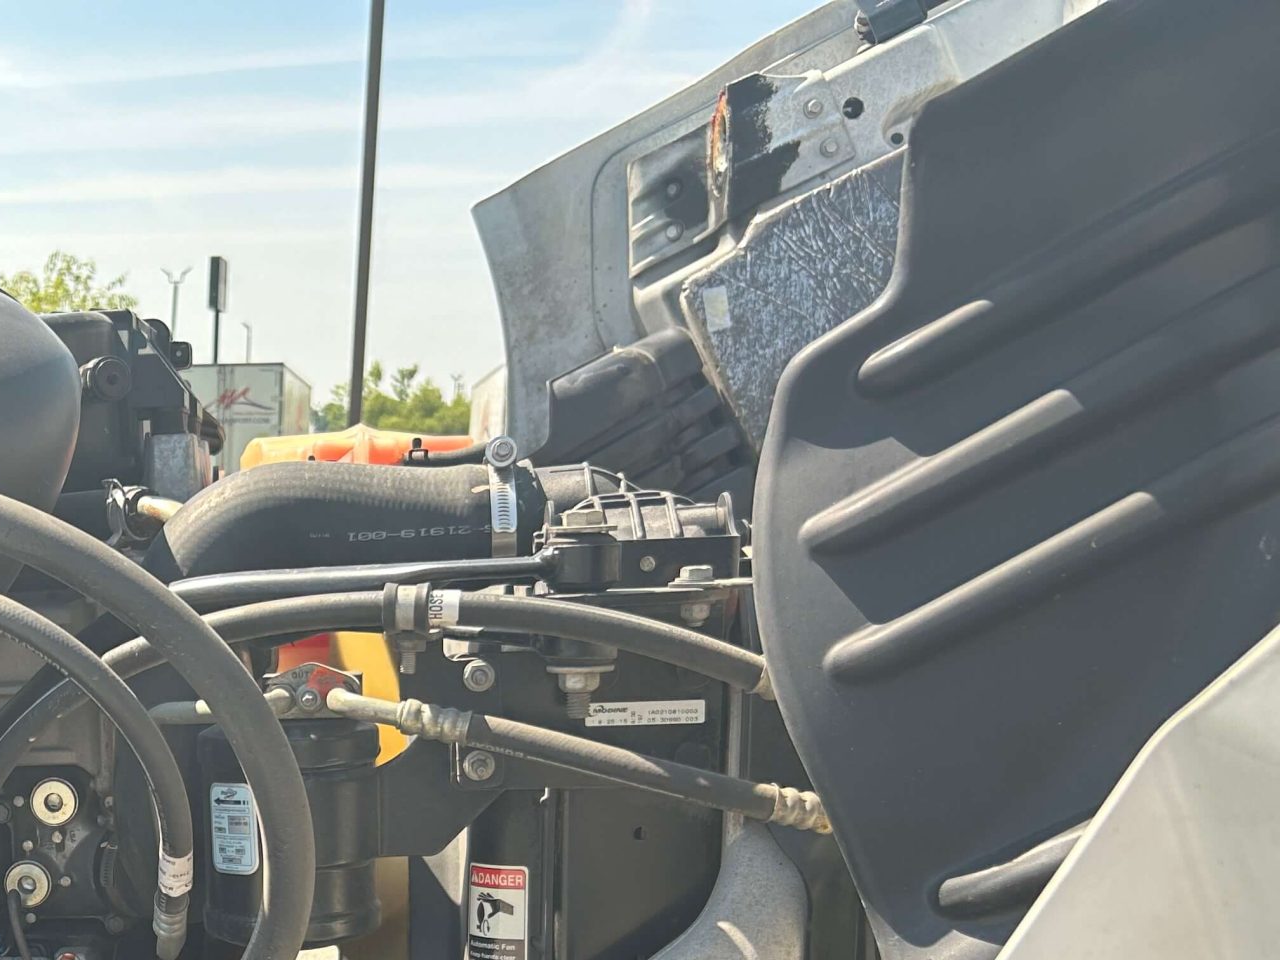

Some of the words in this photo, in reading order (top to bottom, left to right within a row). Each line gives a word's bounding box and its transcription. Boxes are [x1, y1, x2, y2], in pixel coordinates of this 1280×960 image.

[429, 594, 444, 620] HOSE
[478, 874, 524, 887] DANGER
[501, 943, 516, 951] Fan
